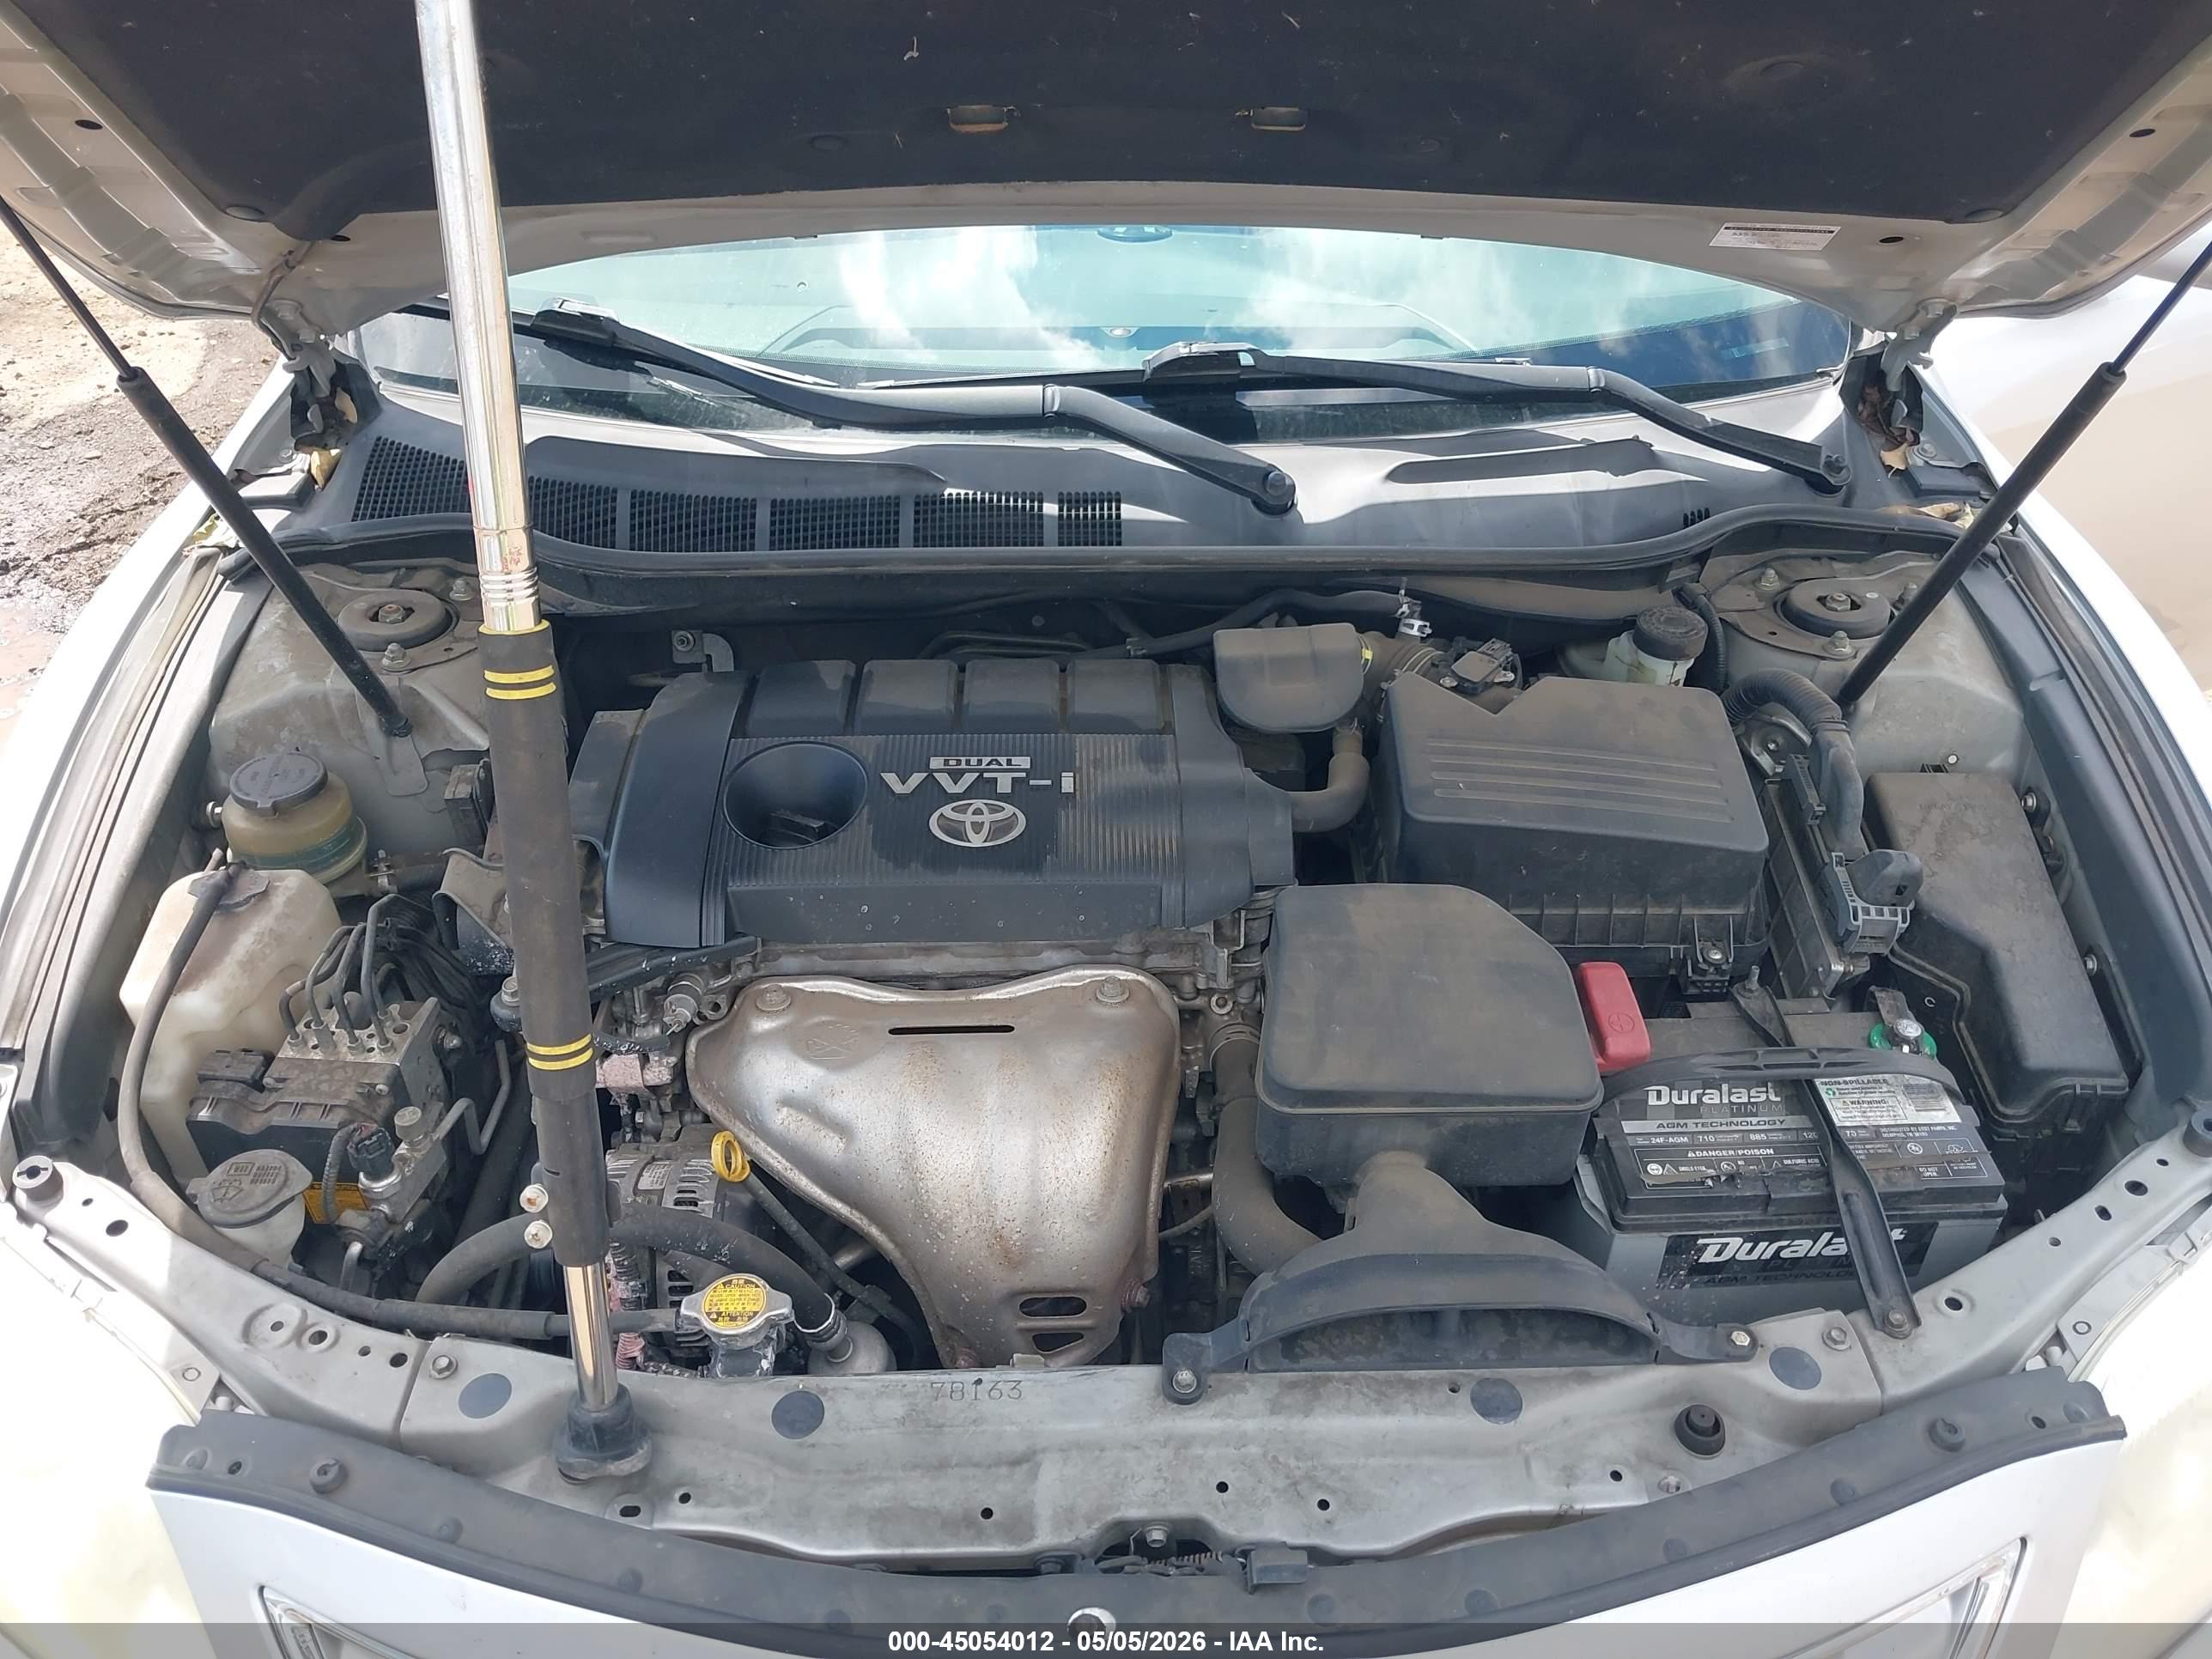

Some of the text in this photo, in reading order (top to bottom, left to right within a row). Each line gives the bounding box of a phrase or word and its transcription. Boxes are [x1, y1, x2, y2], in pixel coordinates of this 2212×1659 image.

[944, 758, 1022, 767] DUAL
[880, 772, 1075, 794] VVT-i
[1642, 1082, 1781, 1105] Duralast
[1700, 1103, 1784, 1114] PLATINUM
[1692, 1119, 1786, 1128] TECHNOLOGY
[1650, 1136, 1689, 1145] 24F-AGM
[1695, 1148, 1774, 1157] DANGER/POISON
[931, 1377, 1023, 1401] 78163
